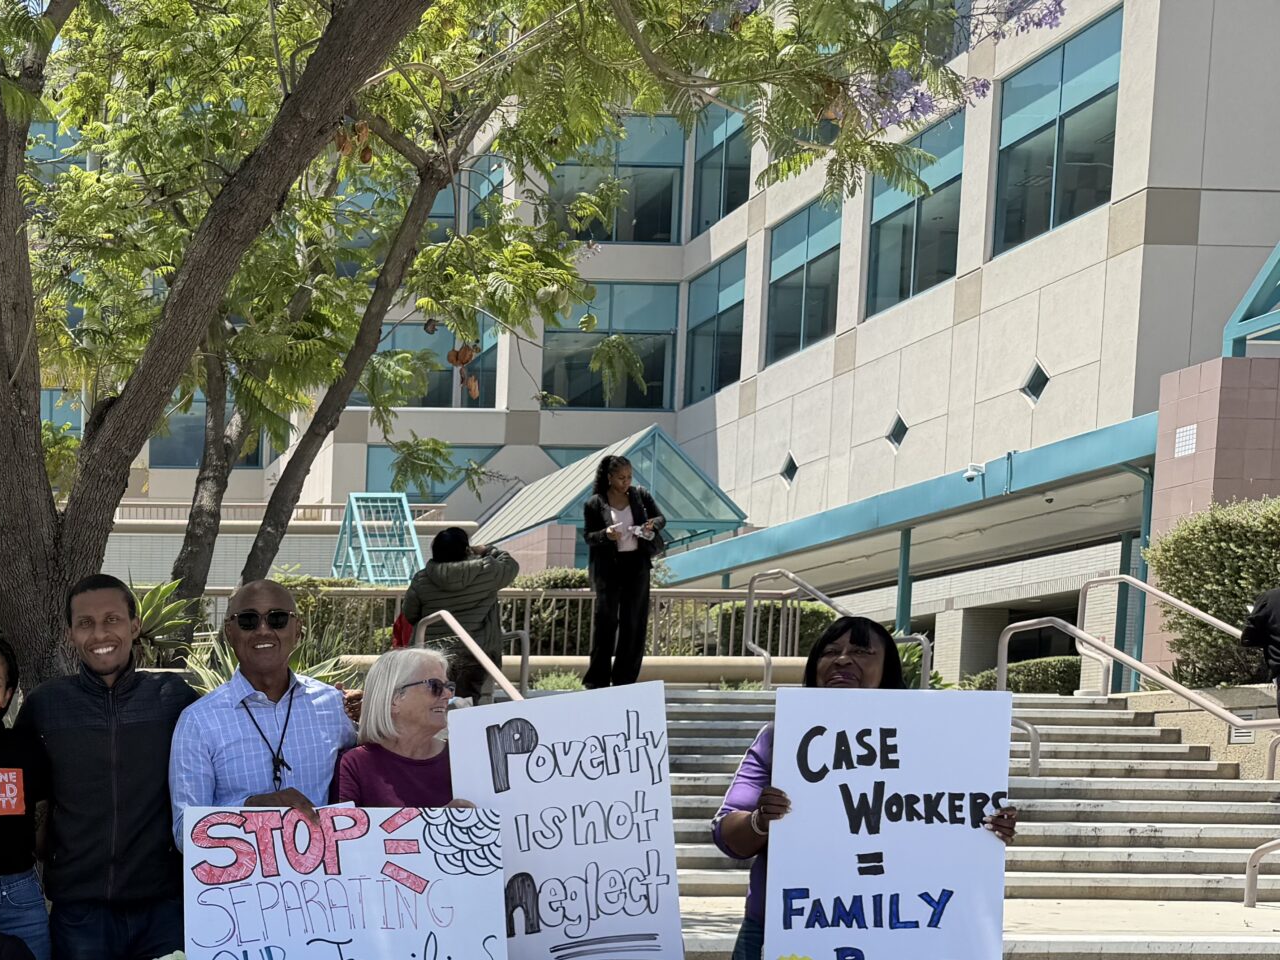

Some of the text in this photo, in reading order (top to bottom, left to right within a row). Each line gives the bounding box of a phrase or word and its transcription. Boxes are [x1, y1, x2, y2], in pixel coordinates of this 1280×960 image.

[484, 709, 668, 795] Poverty
[795, 724, 901, 783] CASE
[190, 807, 371, 886] STOP
[571, 790, 659, 846] not
[190, 874, 454, 949] SEPARATING
[781, 887, 954, 931] FAMILY
